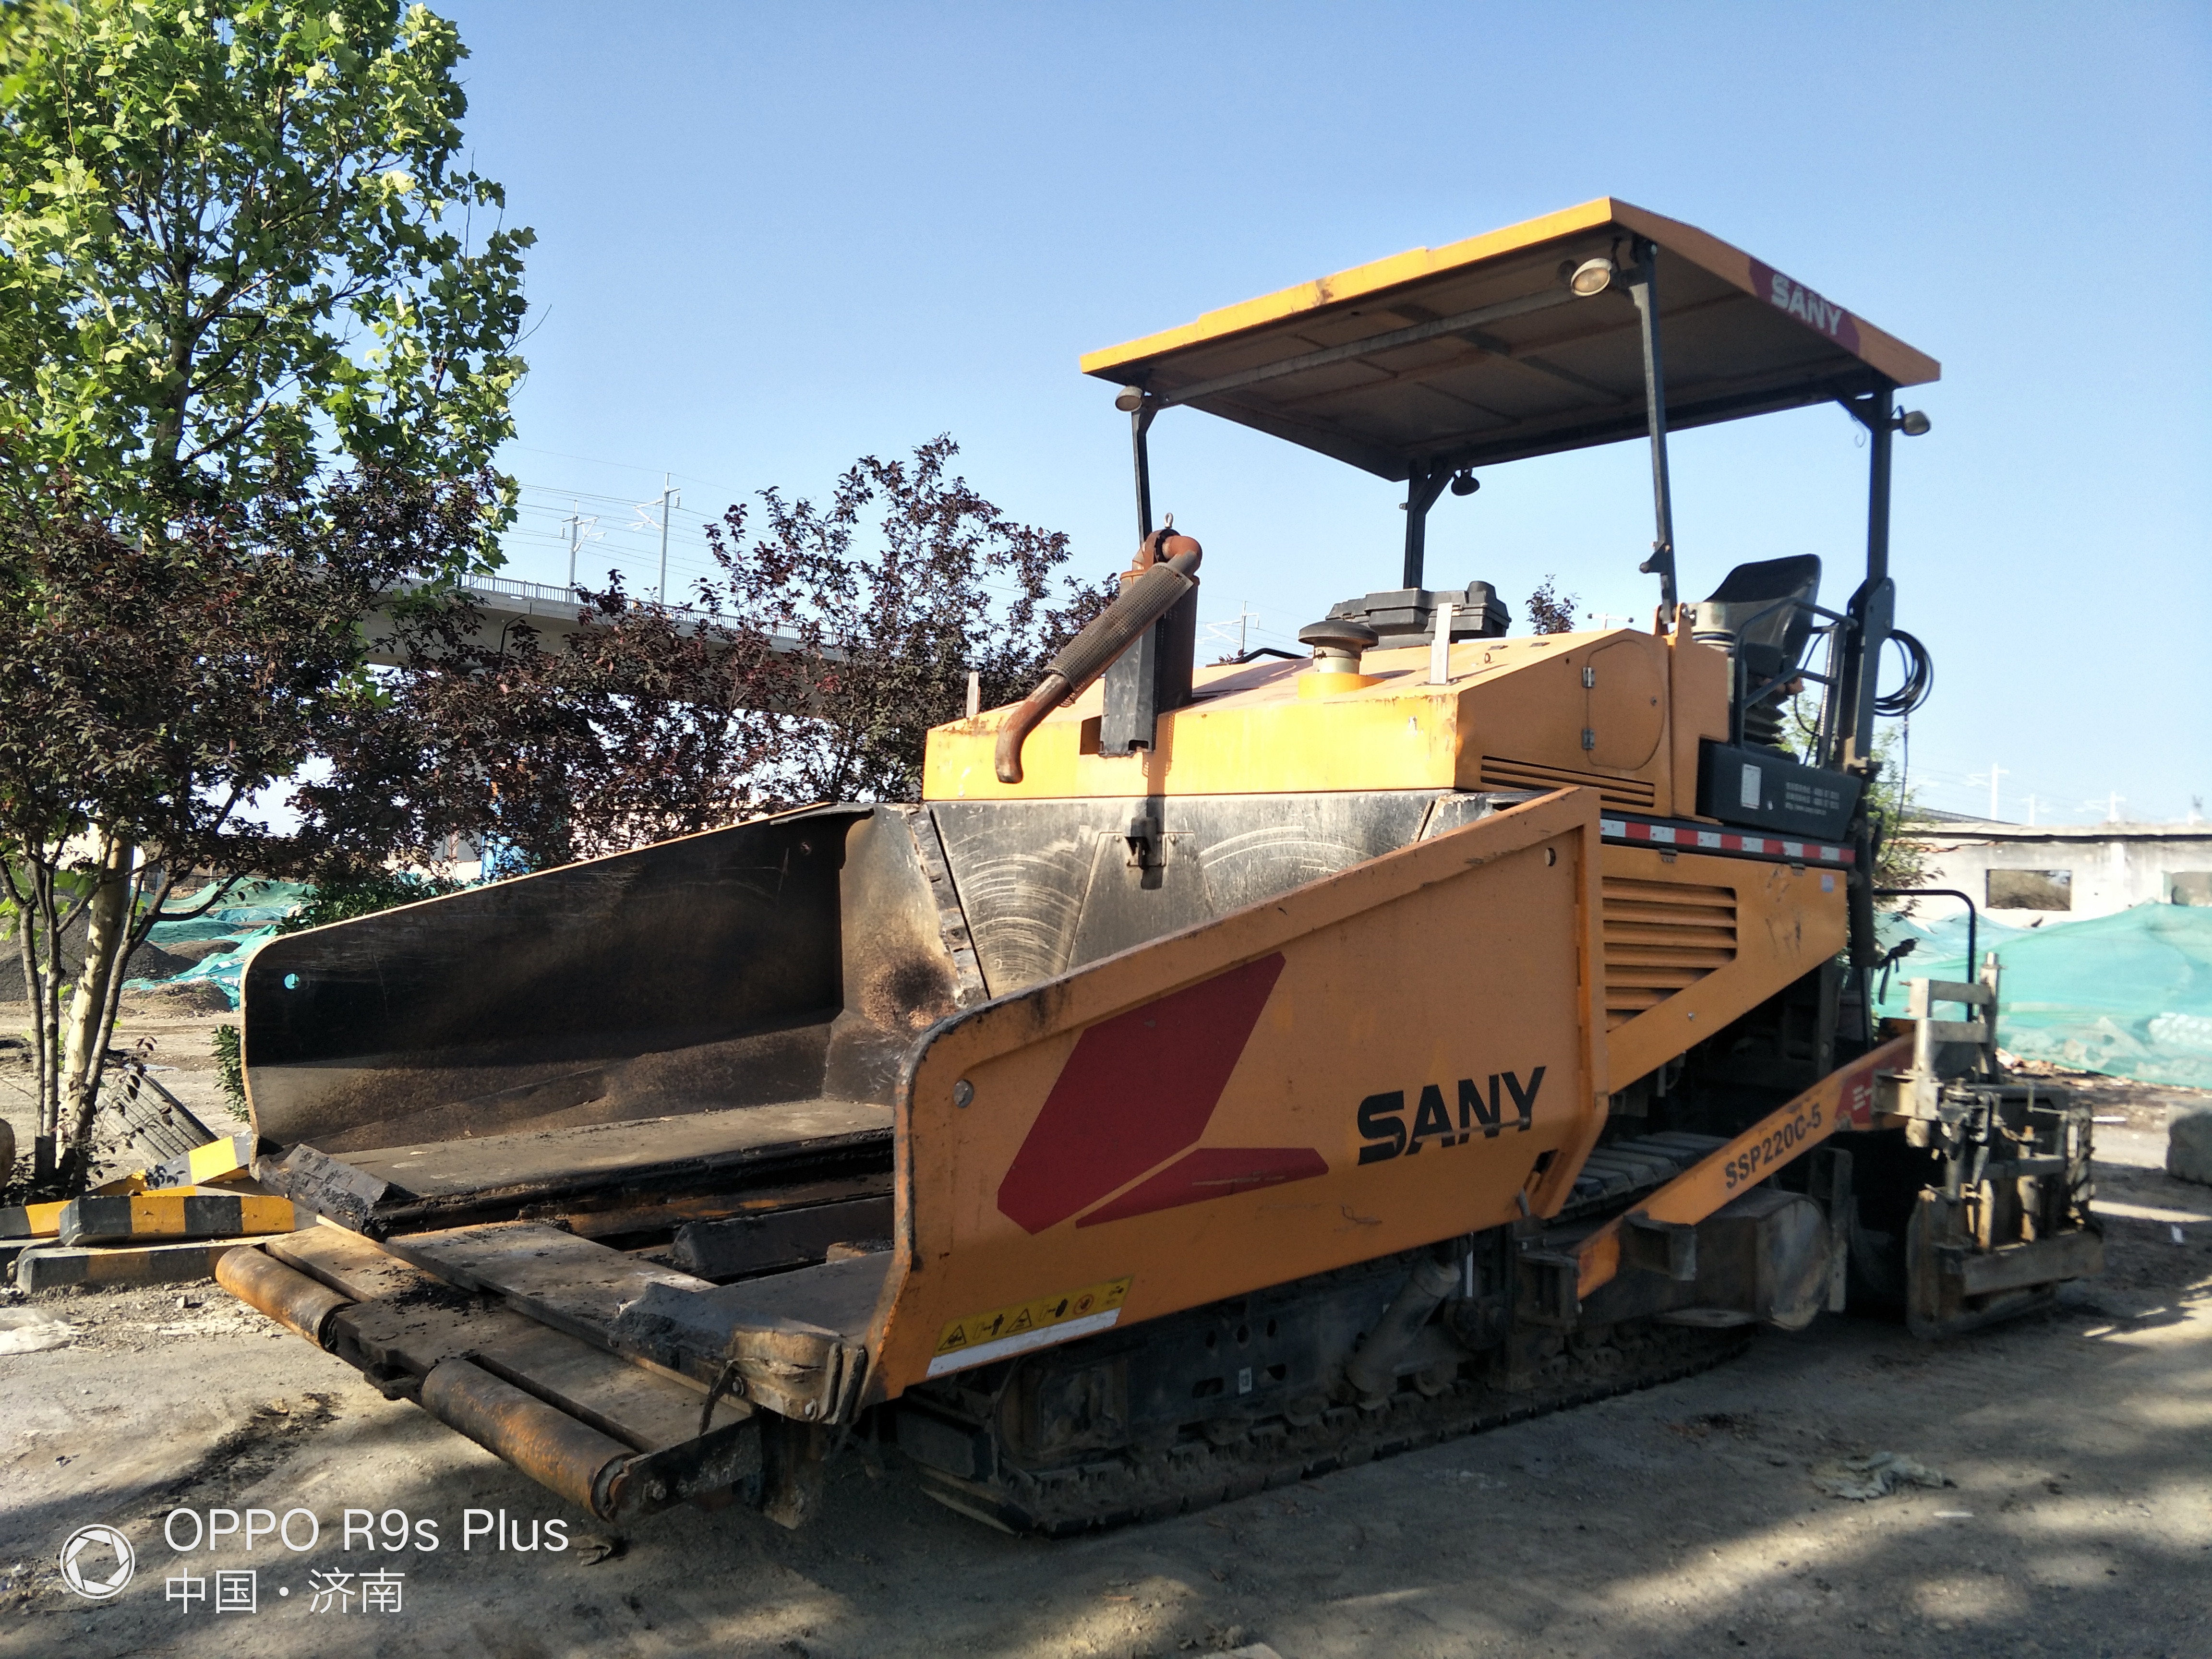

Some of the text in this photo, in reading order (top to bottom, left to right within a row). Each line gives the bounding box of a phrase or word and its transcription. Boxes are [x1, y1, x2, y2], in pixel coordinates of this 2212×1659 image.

[1771, 273, 1842, 336] SANY
[1357, 1065, 1546, 1166] SANY
[1724, 1102, 1822, 1189] SSP220C-5
